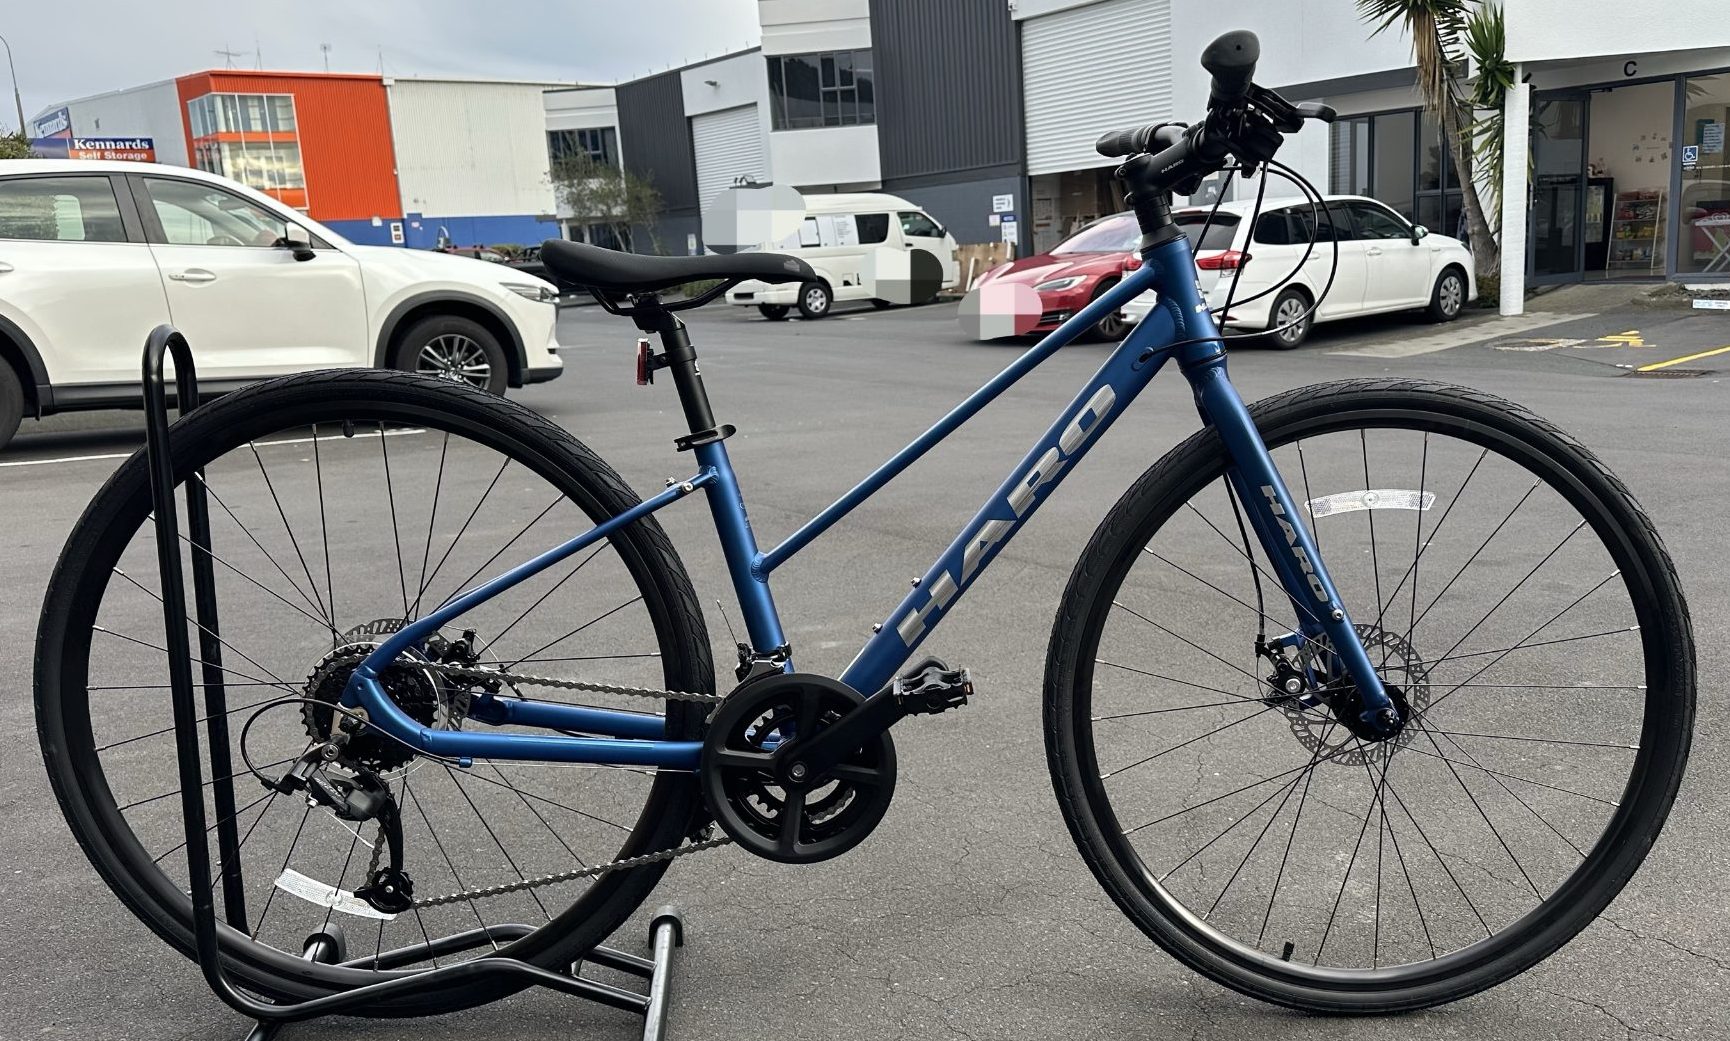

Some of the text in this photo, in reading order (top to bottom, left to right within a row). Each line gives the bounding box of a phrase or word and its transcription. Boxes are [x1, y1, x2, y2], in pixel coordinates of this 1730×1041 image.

[1624, 60, 1637, 77] C
[73, 139, 149, 149] Kennards
[79, 151, 147, 160] Self Storage
[1161, 159, 1184, 174] HARO
[897, 384, 1116, 647] HARO
[1261, 485, 1329, 602] HARO
